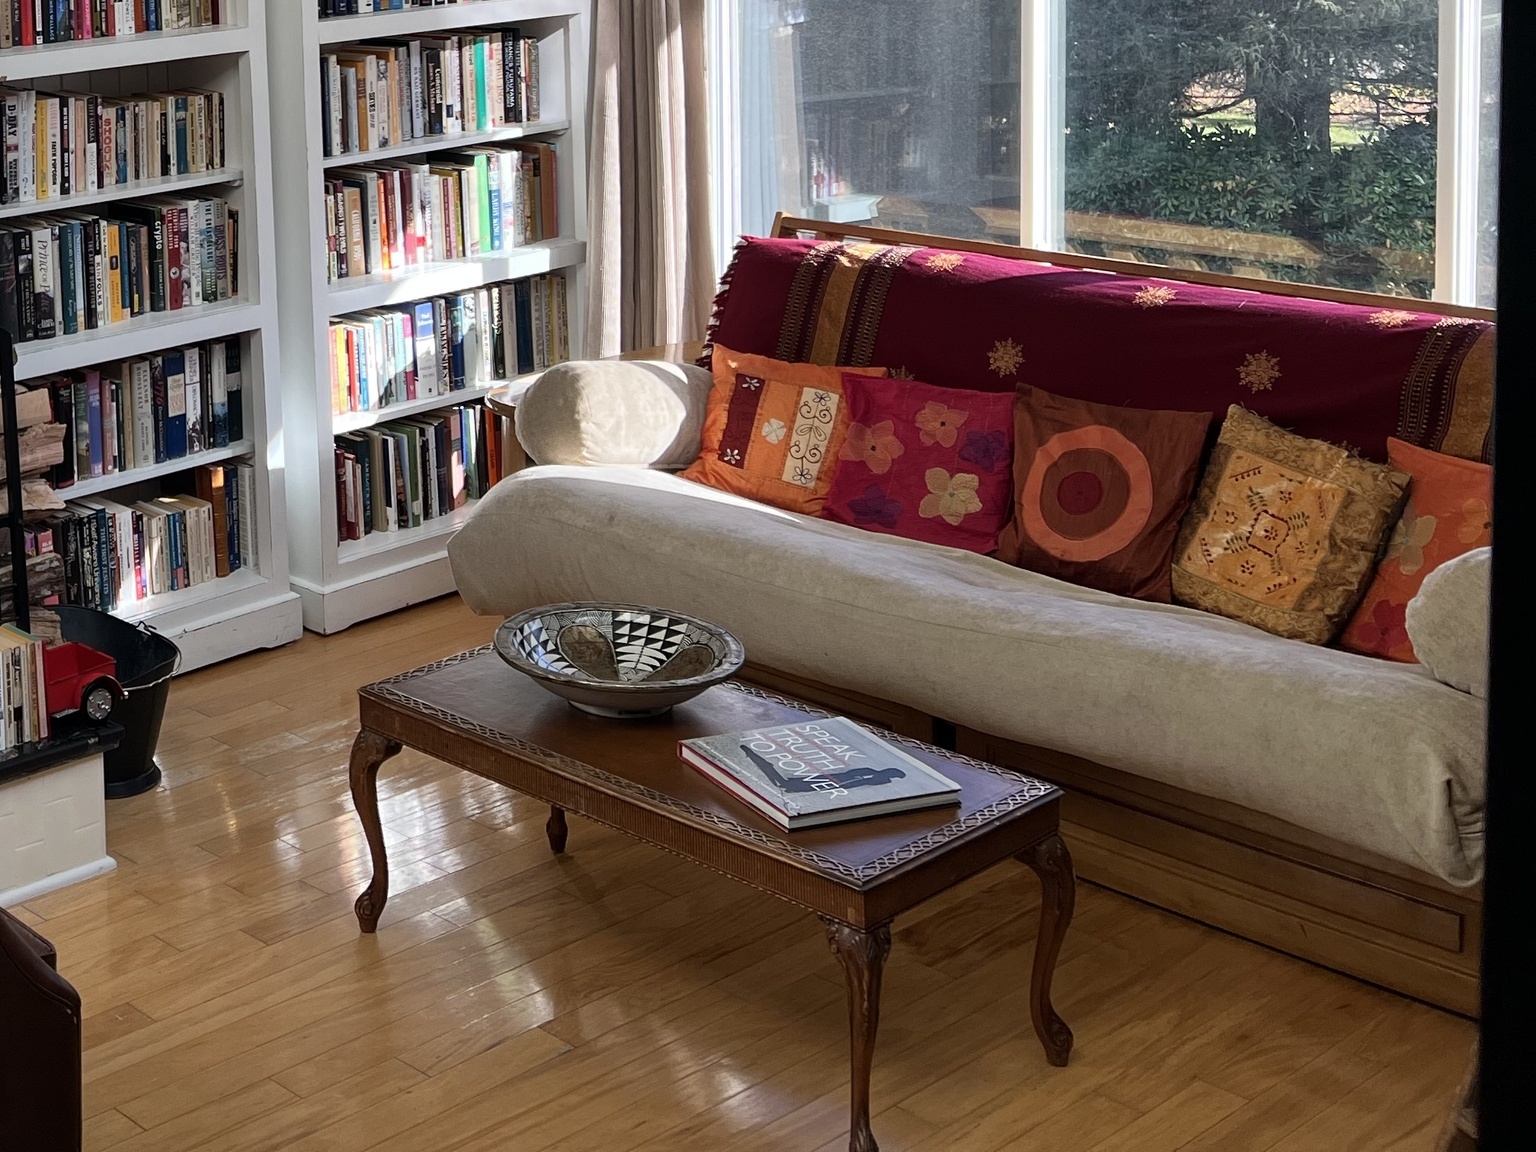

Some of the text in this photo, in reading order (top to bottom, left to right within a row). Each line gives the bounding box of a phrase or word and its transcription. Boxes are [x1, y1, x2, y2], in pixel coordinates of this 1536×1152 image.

[7, 104, 17, 137] D-DAY
[103, 118, 112, 171] SHOGUN
[205, 204, 213, 216] THE
[337, 192, 347, 254] AGAINST TWO EVILS
[491, 193, 501, 236] LARRY KING
[153, 220, 163, 250] crypto
[215, 224, 227, 281] GRASS ROOTS
[95, 262, 103, 306] KINFOLKS
[440, 324, 449, 379] TAKING SIDES
[769, 729, 845, 770] TRUTH
[795, 724, 867, 761] SPEAK
[739, 733, 777, 754] TO
[773, 752, 850, 800] POWER
